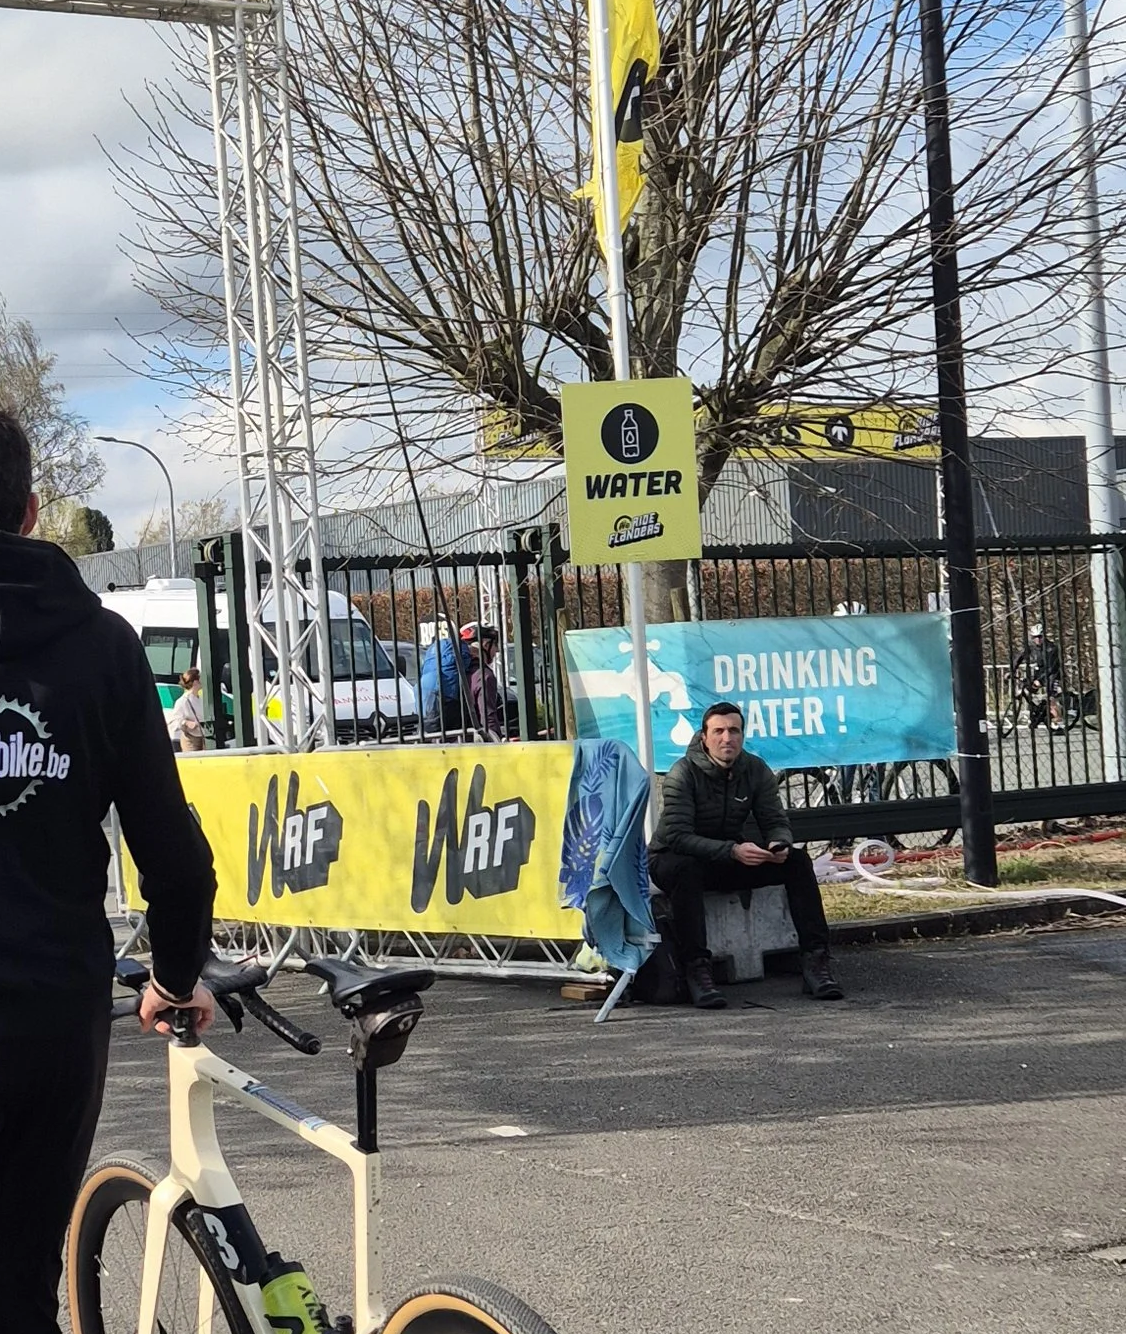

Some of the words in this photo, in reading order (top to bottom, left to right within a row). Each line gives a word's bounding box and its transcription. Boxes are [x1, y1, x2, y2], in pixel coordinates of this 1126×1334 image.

[585, 470, 683, 500] WATER
[632, 512, 658, 527] RIDE
[714, 646, 878, 693] DRINKING
[737, 697, 826, 739] ATER
